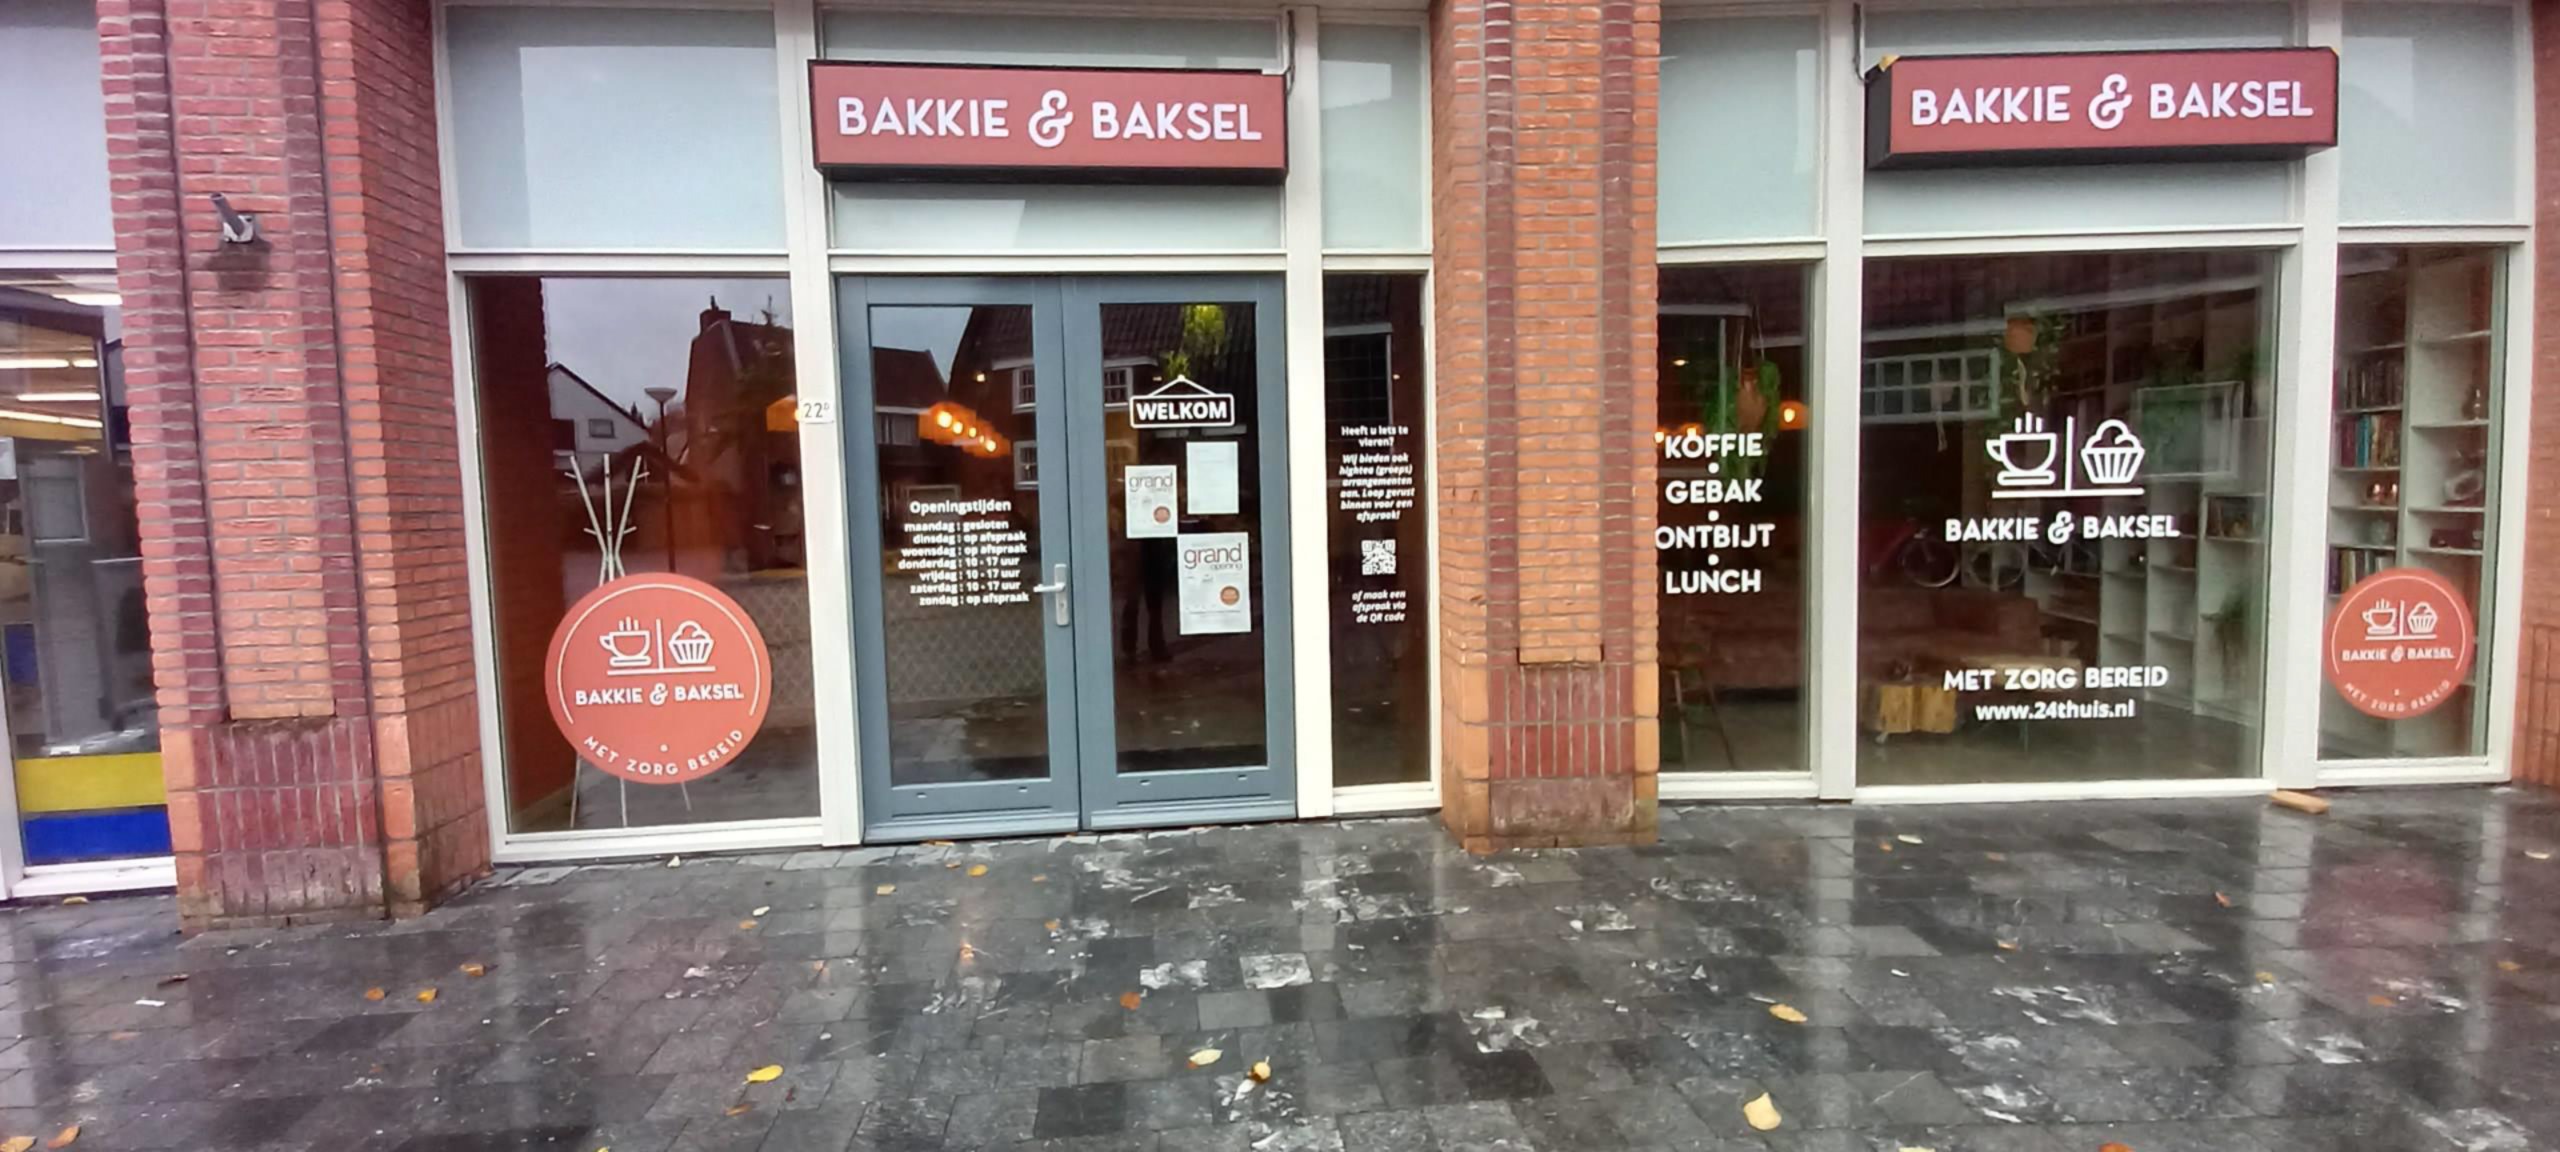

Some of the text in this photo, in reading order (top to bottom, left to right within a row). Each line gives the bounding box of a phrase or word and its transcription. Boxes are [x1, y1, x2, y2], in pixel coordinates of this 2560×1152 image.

[1911, 73, 2314, 130] BAKKIE & BAKSEL
[838, 89, 1263, 148] BAKKIE & BAKSEL
[1136, 401, 1227, 420] WELKOM
[1341, 425, 1368, 436] Heeft
[1370, 427, 1377, 435] u
[1399, 426, 1408, 435] te
[1358, 437, 1394, 447] vieren?
[1665, 433, 1763, 459] KOFFIE
[1359, 453, 1390, 463] bieden
[1392, 452, 1408, 462] ook
[1129, 472, 1173, 492] grand
[1342, 477, 1412, 488] arrangementen
[1362, 488, 1384, 499] Loop
[1385, 488, 1415, 499] gerust
[1665, 478, 1763, 504] GEBAK
[909, 499, 1012, 516] Openingstijden
[1340, 500, 1413, 510] binnen voor een
[904, 521, 955, 533] maandag
[963, 520, 1009, 532] gesloten
[1945, 510, 2180, 545] BAKKIE & BAKSEL
[913, 534, 955, 545] dinsdag
[963, 535, 978, 545] op
[980, 531, 1027, 543] afspraak
[1655, 523, 1775, 549] ONTBIJT
[901, 546, 956, 557] woensdag
[964, 548, 978, 557] op
[980, 544, 1027, 556] afspraak
[1184, 543, 1242, 569] grand
[898, 558, 957, 570] donderdag
[965, 558, 978, 567] 10
[986, 557, 999, 566] 17
[1001, 557, 1020, 566] uur
[919, 570, 958, 582] vrijdag
[966, 570, 978, 579] 10
[987, 569, 999, 578] 17
[1001, 569, 1020, 578] uur
[1666, 569, 1761, 594] LUNCH
[910, 583, 958, 594] zaterdag
[966, 582, 978, 591] 10
[987, 581, 999, 591] 17
[1001, 581, 1021, 591] uur
[1363, 589, 1388, 599] maak
[1390, 591, 1406, 599] een
[919, 595, 958, 607] zondag
[966, 597, 980, 606] op
[982, 592, 1029, 605] afspraak
[1352, 601, 1406, 613] afspraak via
[1356, 611, 1405, 624] de QR code
[2342, 645, 2455, 662] BAKKIE & BAKSEL
[1943, 666, 2169, 691] MET ZORG BEREID
[576, 683, 744, 705] BAKKIE & BAKSEL
[2345, 680, 2450, 712] MET ZORG BEREID
[1975, 698, 2135, 720] www.24thuis.nl
[584, 730, 743, 775] MET ZORG BEREID
